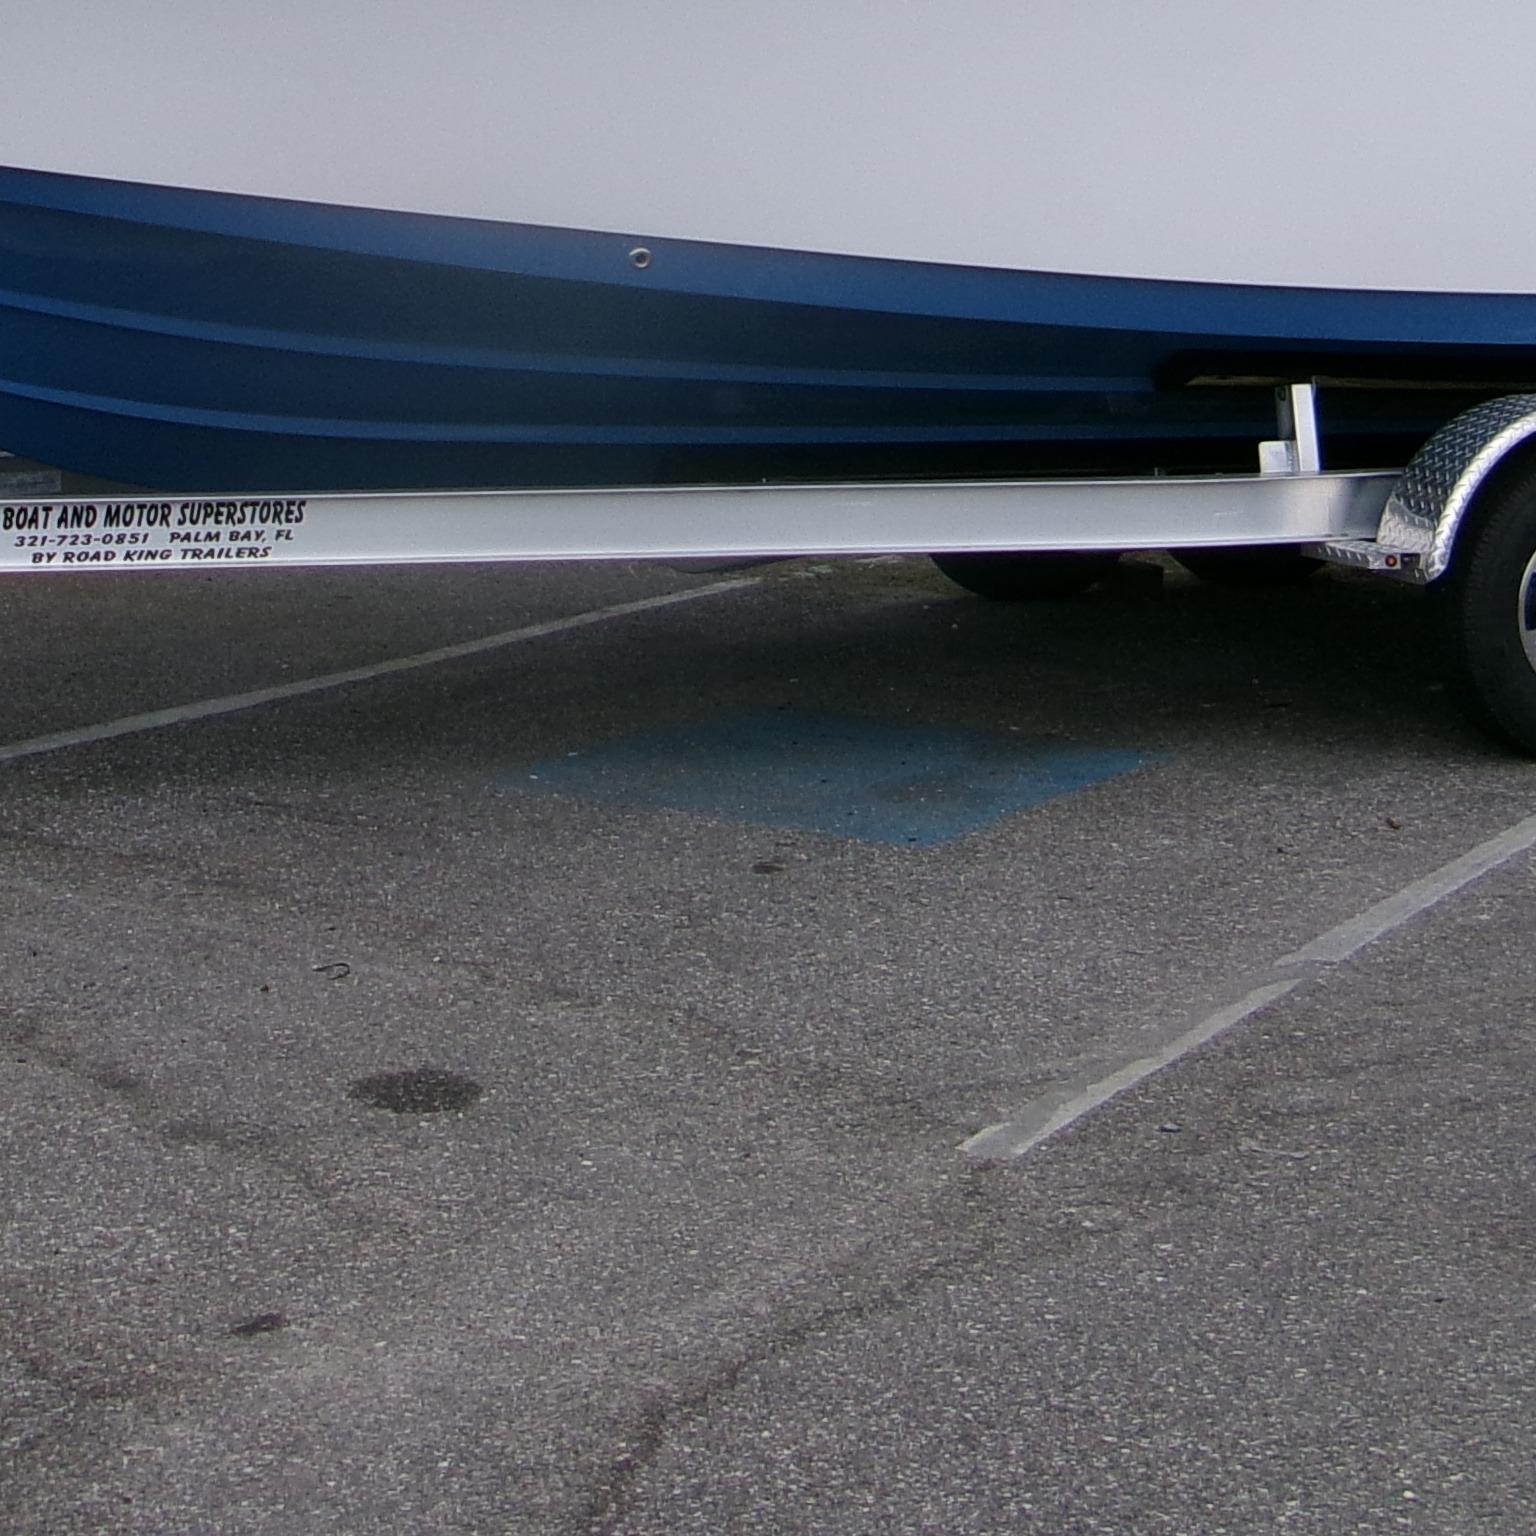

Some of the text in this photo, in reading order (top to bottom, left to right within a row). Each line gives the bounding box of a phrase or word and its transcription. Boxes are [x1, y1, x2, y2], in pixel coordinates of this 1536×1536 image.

[2, 499, 307, 531] BOAT AND MOTOR SUPERSTORES
[13, 528, 294, 547] 321-723-0851 PALM BAY, FL
[31, 546, 273, 564] BY ROAD KING TRAILERS
